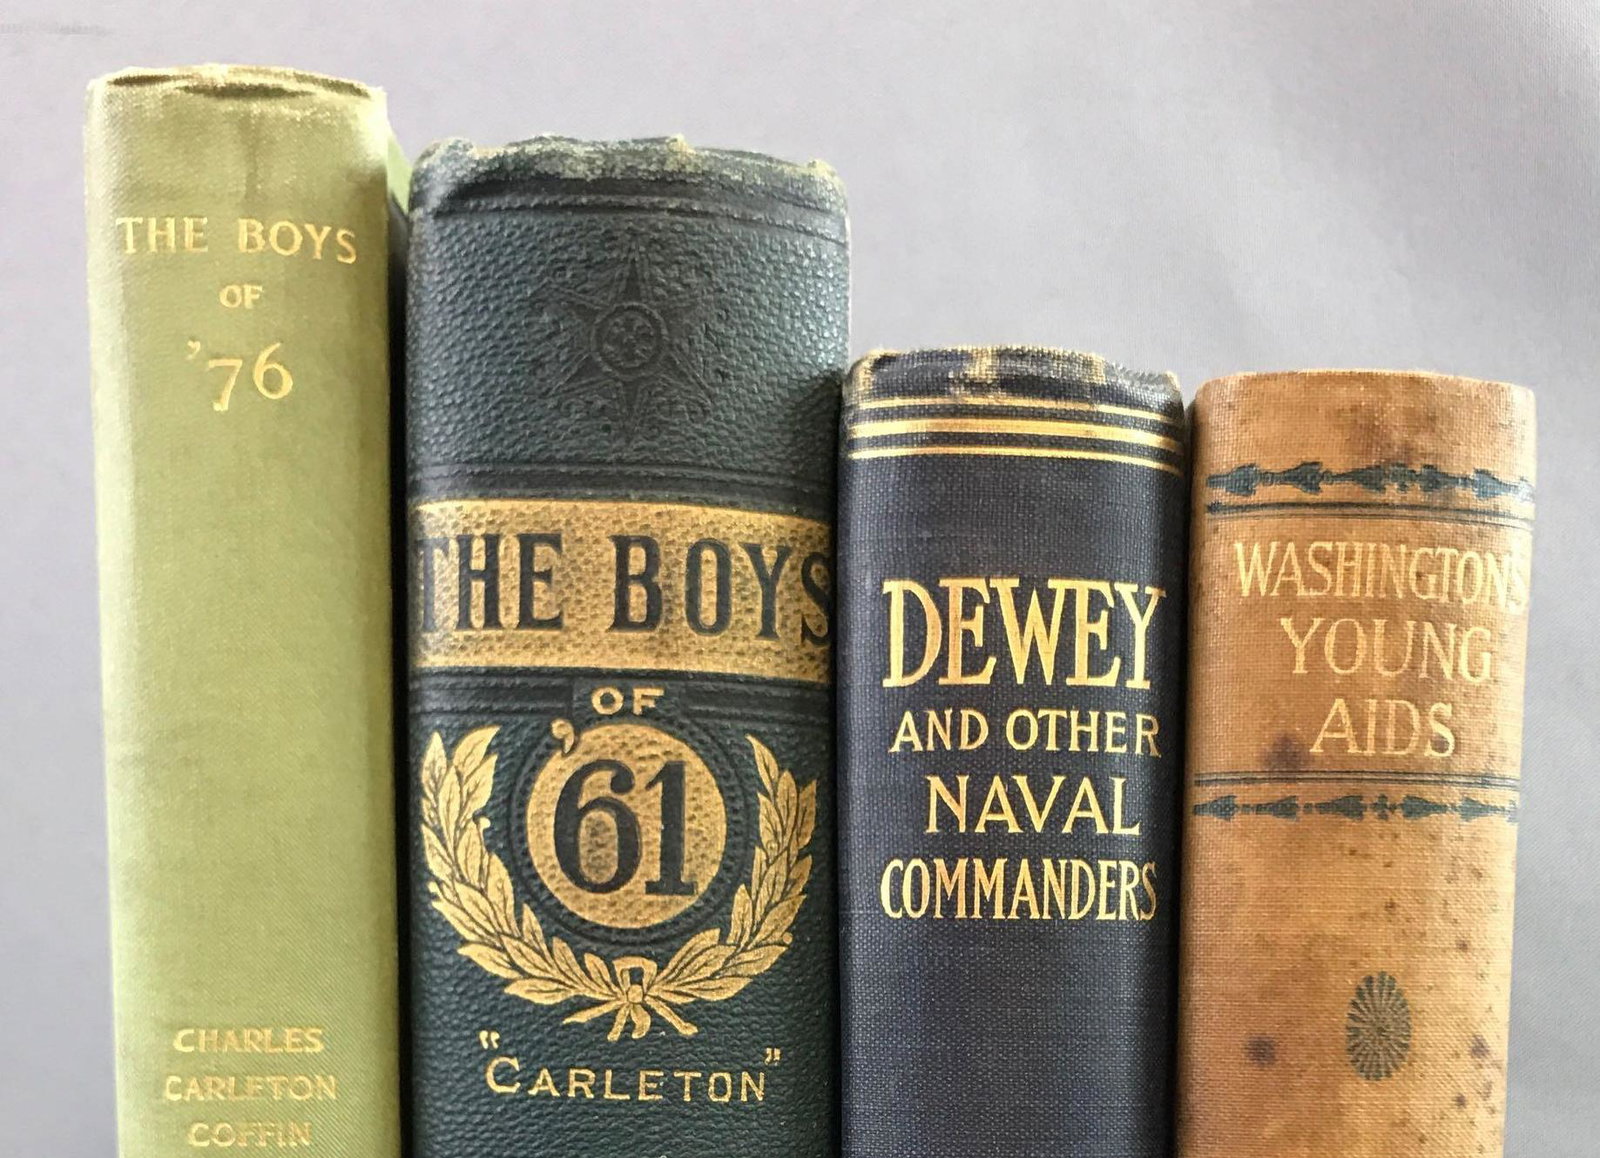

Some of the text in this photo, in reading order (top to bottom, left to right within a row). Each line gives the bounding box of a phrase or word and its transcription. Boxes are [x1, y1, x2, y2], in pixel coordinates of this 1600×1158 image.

[116, 216, 357, 265] THE BOYS
[219, 284, 262, 309] OF
[187, 339, 294, 412] '76
[417, 532, 833, 646] THE BOYS
[882, 577, 1167, 690] DEWEY
[1280, 617, 1493, 683] YOUNG
[591, 687, 665, 716] OF
[1309, 698, 1456, 757] AIDS
[889, 707, 1162, 758] AND OTHER
[925, 774, 1141, 836] NAVAL
[880, 857, 1158, 922] COMMANDERS
[173, 1027, 325, 1054] CHARLES
[165, 1074, 338, 1102] CARLETON
[187, 1121, 312, 1148] COFFIN
